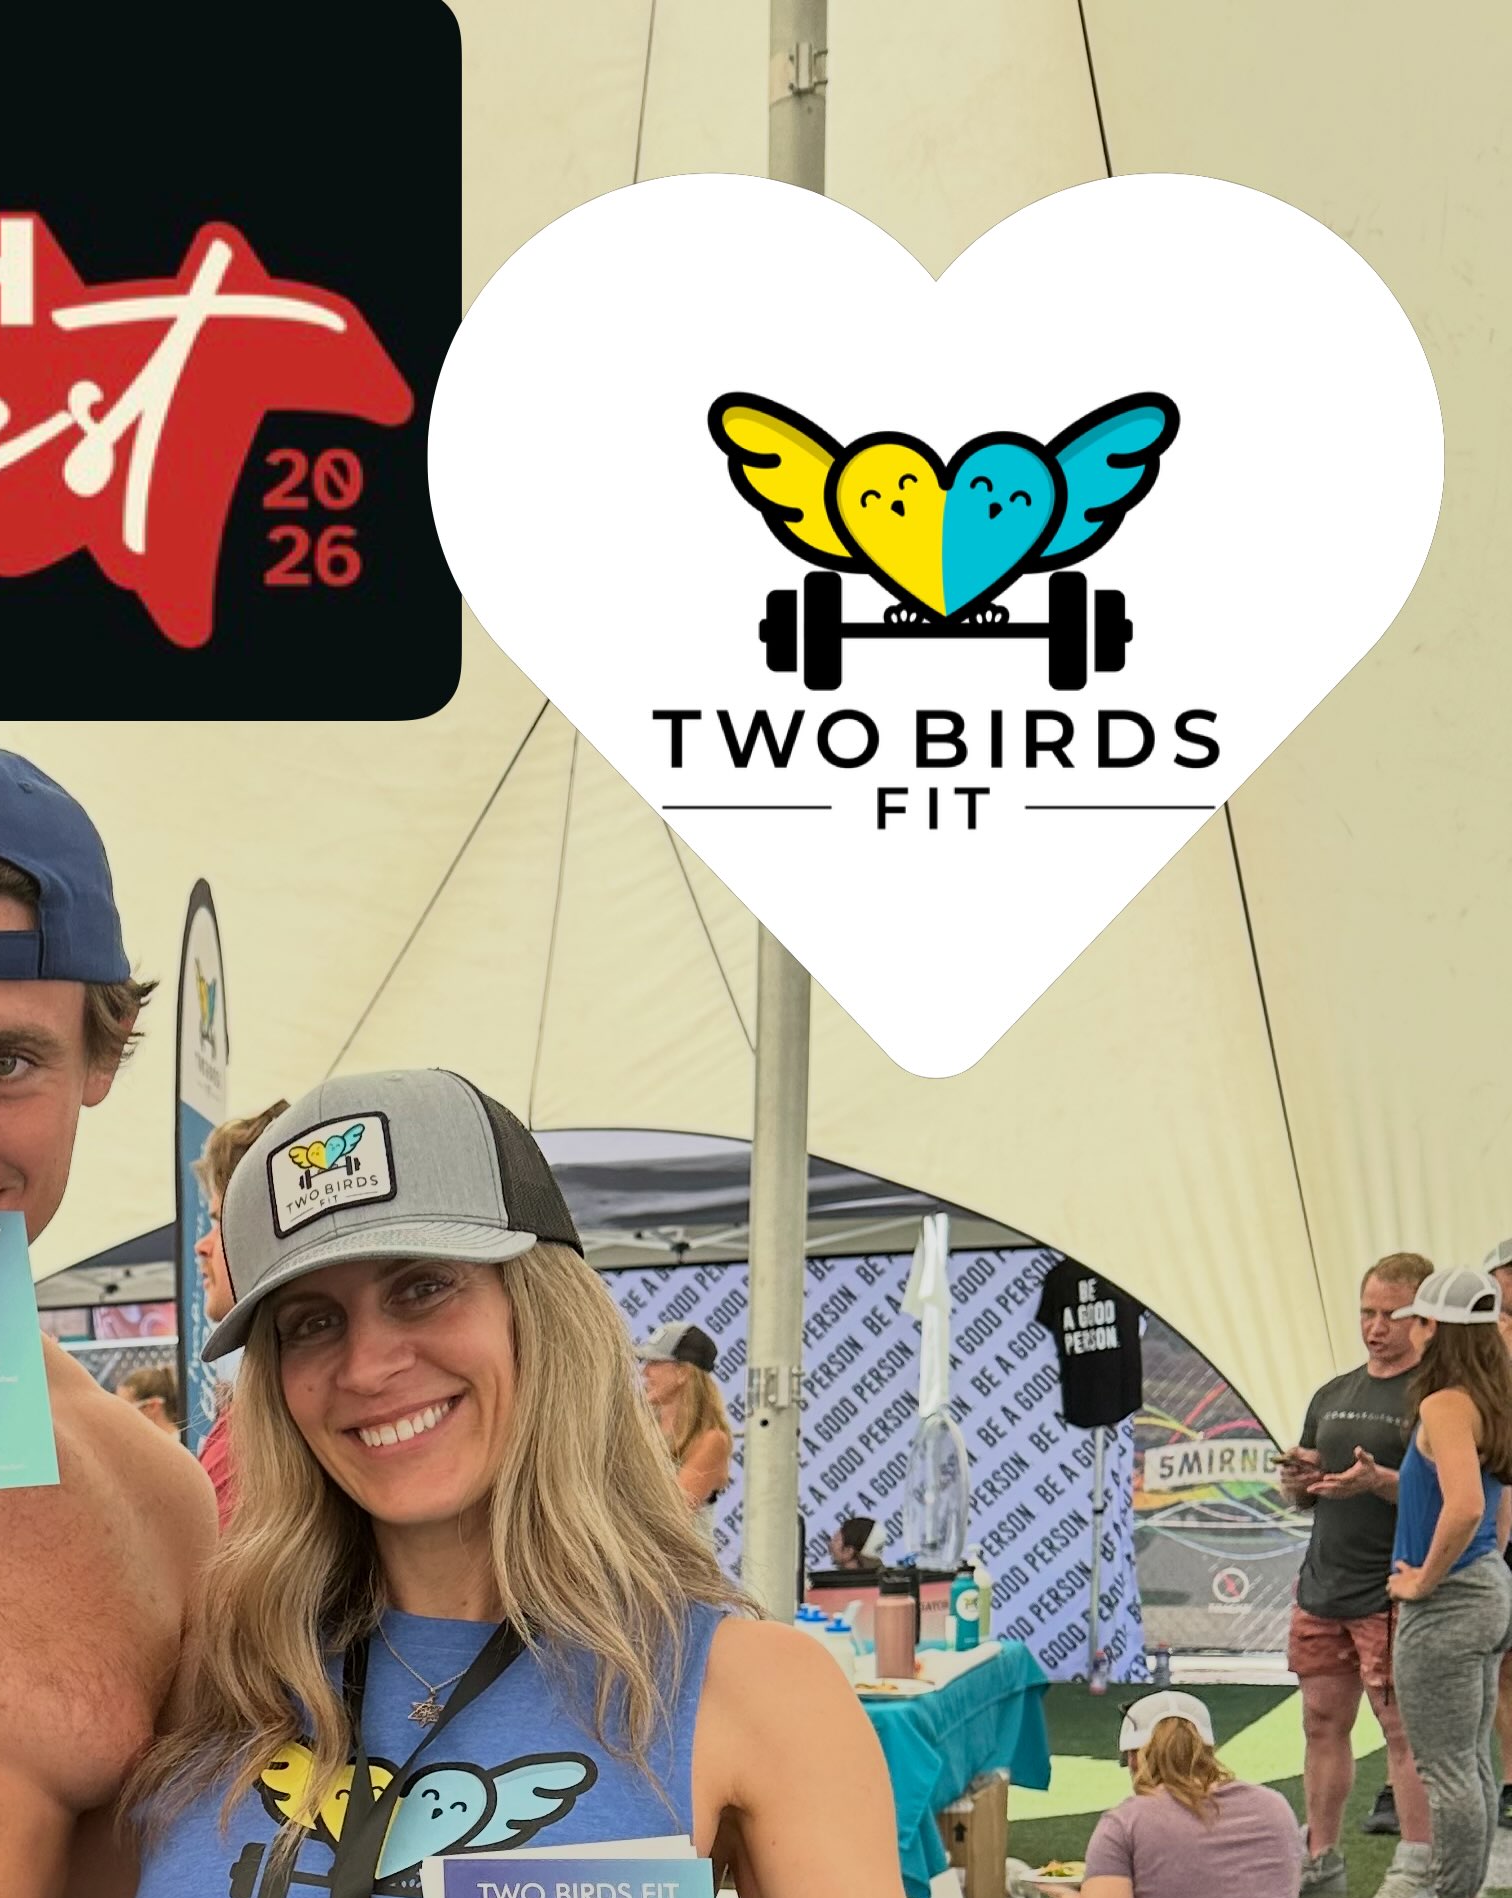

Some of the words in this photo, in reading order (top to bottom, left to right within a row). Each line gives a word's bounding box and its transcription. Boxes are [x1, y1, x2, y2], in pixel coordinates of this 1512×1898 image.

[286, 1189, 320, 1215] TWO
[325, 1175, 379, 1195] BIRDS
[320, 1195, 338, 1207] FIT
[619, 1288, 648, 1318] BE
[640, 1276, 659, 1297] A
[658, 1285, 700, 1323] GOOD
[949, 1256, 995, 1305] GOOD
[1078, 1278, 1097, 1303] BE
[704, 1288, 748, 1335] GOOD
[955, 1307, 1002, 1355] GOOD
[1063, 1306, 1075, 1331] A
[1077, 1299, 1116, 1329] GOOD
[803, 1335, 864, 1399] PERSON
[861, 1305, 892, 1337] BE
[970, 1365, 1002, 1398] BE
[995, 1354, 1016, 1376] A
[1007, 1320, 1046, 1360] GOO
[814, 1396, 859, 1443] GOOD
[851, 1340, 914, 1404] PERSON
[976, 1416, 1007, 1448] BE
[1001, 1405, 1021, 1427] A
[1014, 1364, 1061, 1411] GOOD
[808, 1485, 827, 1506] A
[820, 1446, 865, 1493] GOOD
[857, 1389, 920, 1454] PERSON
[969, 1451, 1030, 1516] PERSON
[1028, 1422, 1059, 1453] BE
[1159, 1448, 1277, 1479] SMIRNO
[857, 1491, 877, 1512] A
[1034, 1474, 1065, 1505] BE
[1059, 1461, 1080, 1484] A
[1024, 1509, 1089, 1573] PERSON
[1029, 1560, 1092, 1624] PERSON
[1039, 1622, 1086, 1670] GOOD
